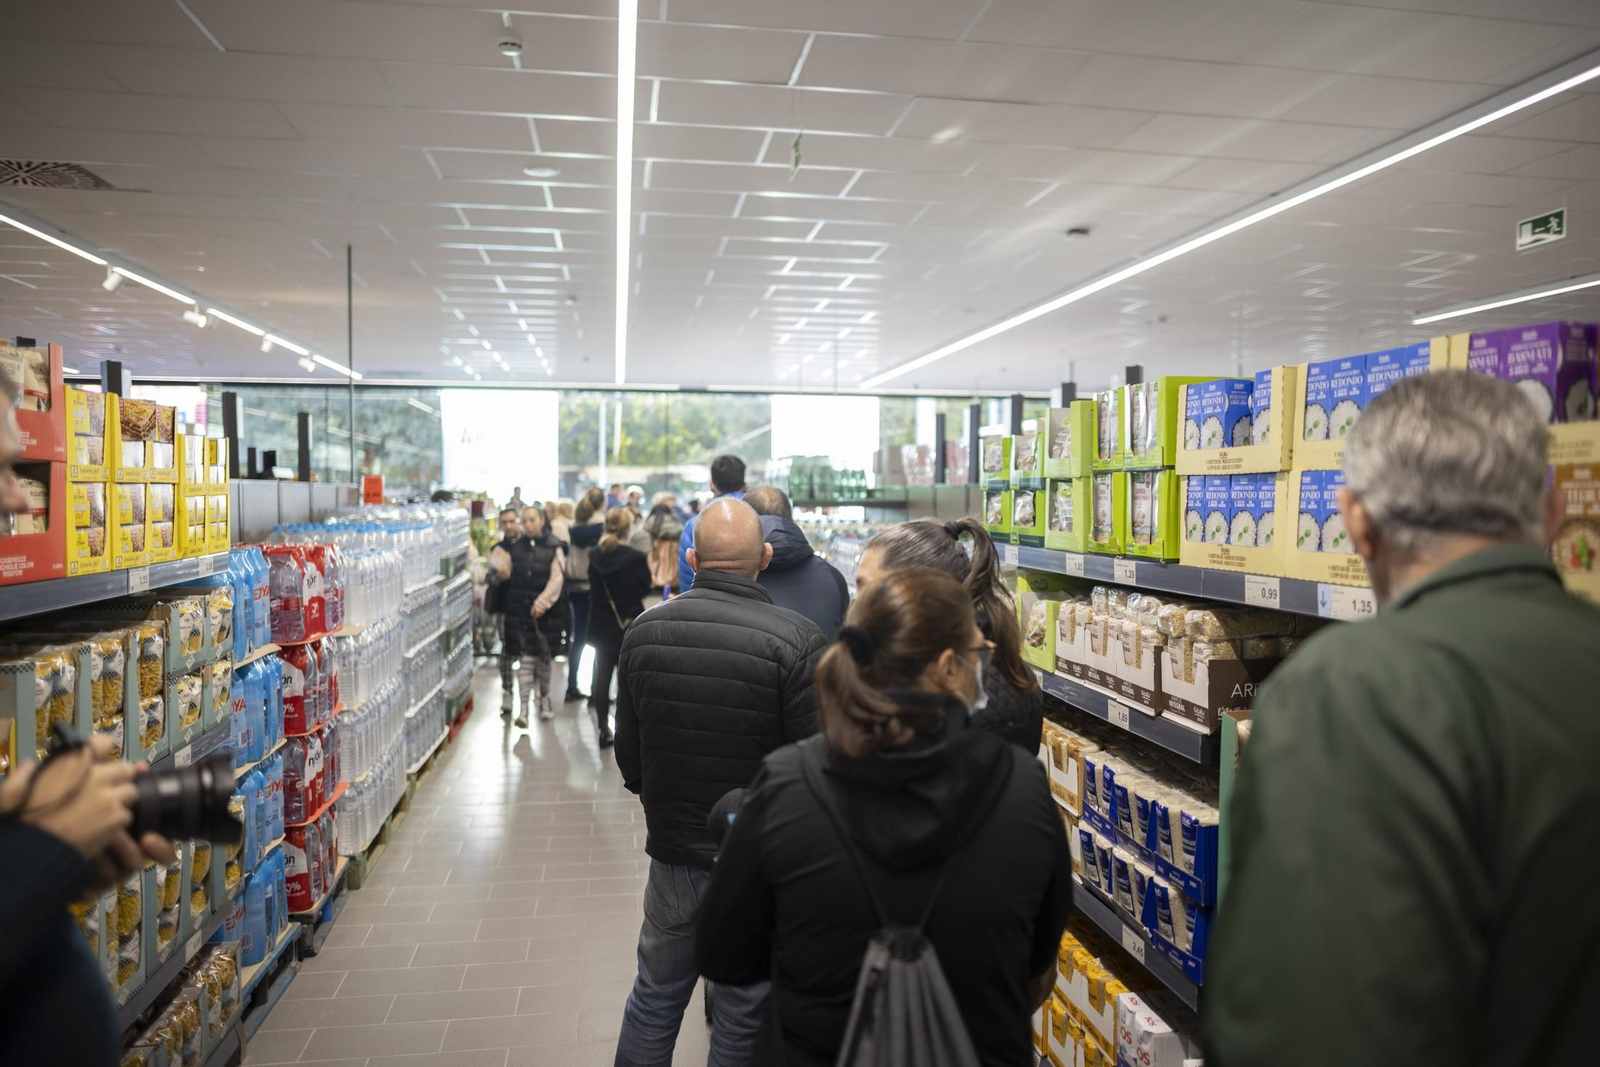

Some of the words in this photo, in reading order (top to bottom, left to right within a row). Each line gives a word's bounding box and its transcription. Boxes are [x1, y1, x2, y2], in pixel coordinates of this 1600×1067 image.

[1331, 376, 1363, 388] REDONDO
[1367, 370, 1403, 383] REDONDO
[1202, 396, 1224, 407] REDONDO
[1206, 491, 1228, 499] REDONDO
[1231, 491, 1257, 499] REDONDO
[1124, 570, 1135, 579] 1,39
[1261, 587, 1278, 600] 0,99
[1351, 599, 1373, 614] 1,35
[1169, 700, 1185, 712] INTEGRAL
[1132, 942, 1144, 957] 2,45
